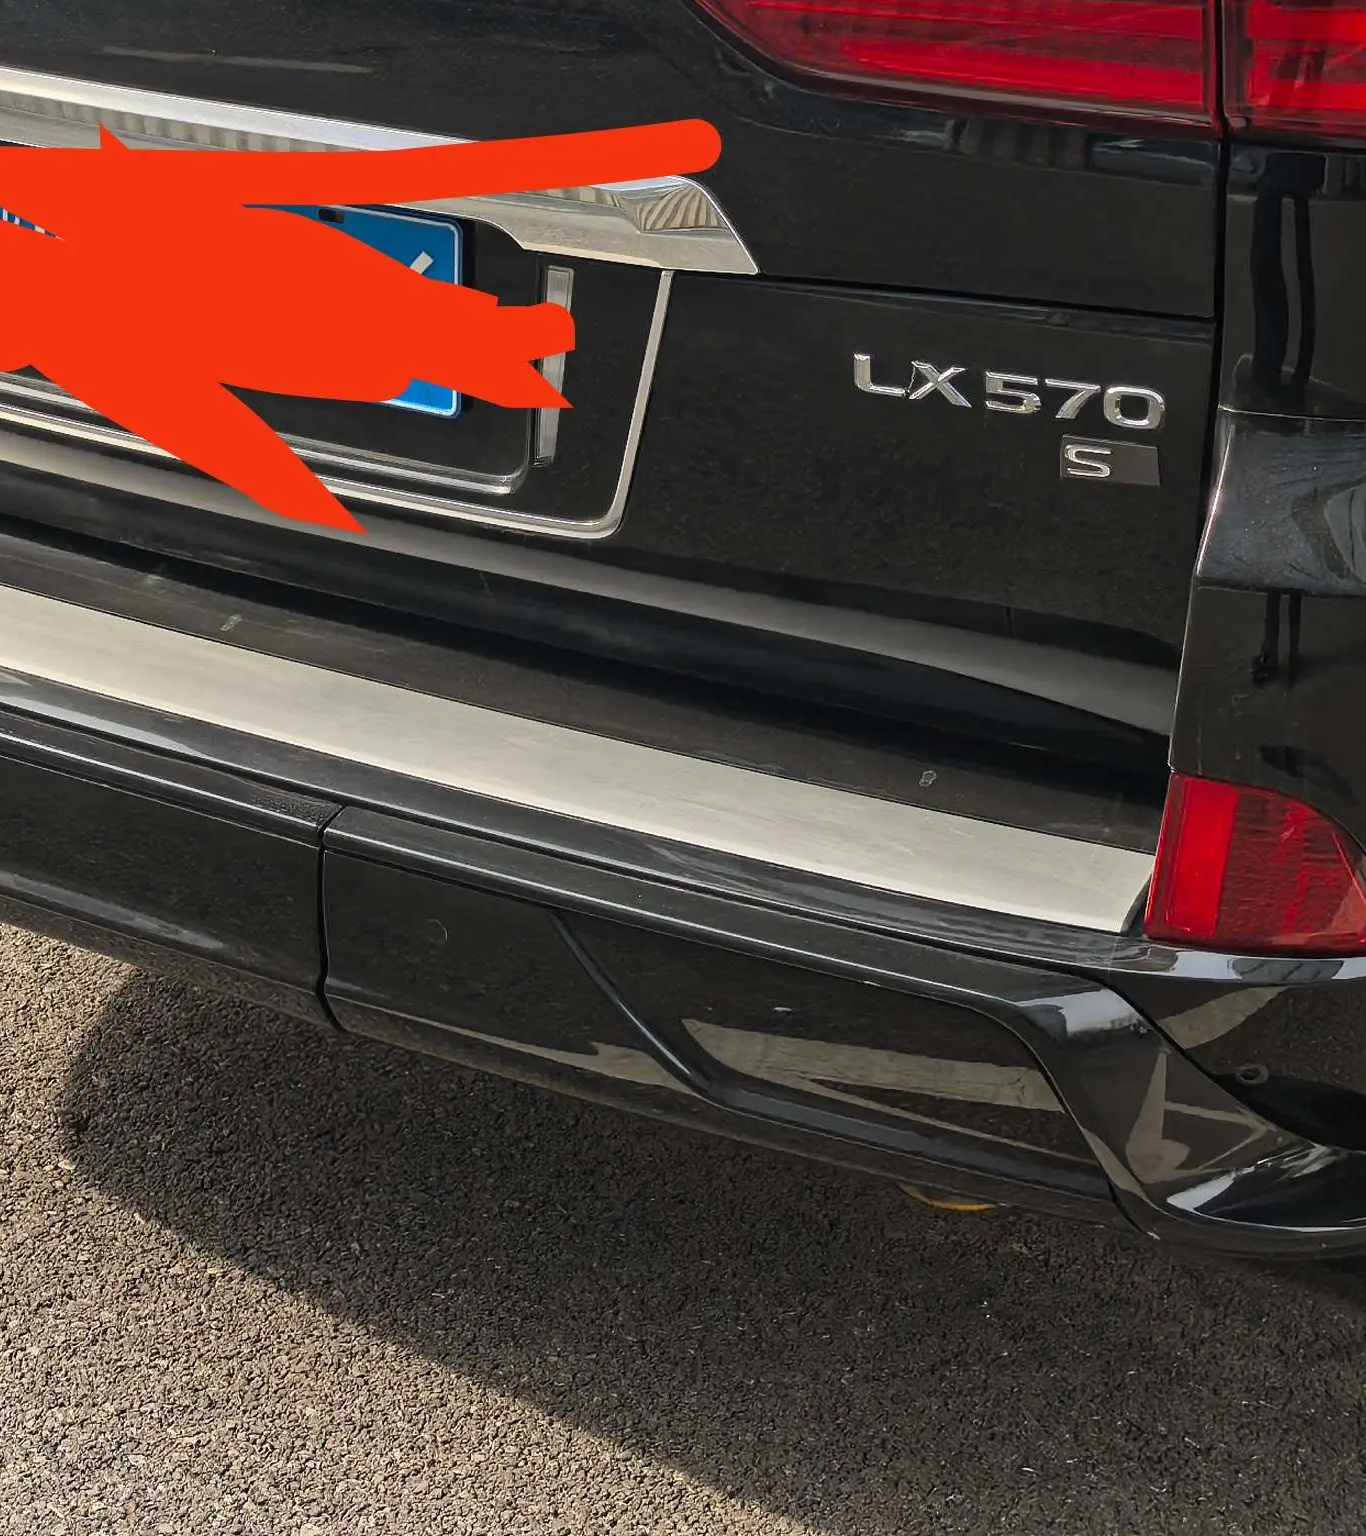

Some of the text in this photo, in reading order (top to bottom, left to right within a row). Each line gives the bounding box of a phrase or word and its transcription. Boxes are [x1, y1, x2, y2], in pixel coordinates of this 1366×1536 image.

[854, 353, 1166, 430] LX 570
[1065, 444, 1112, 478] S
